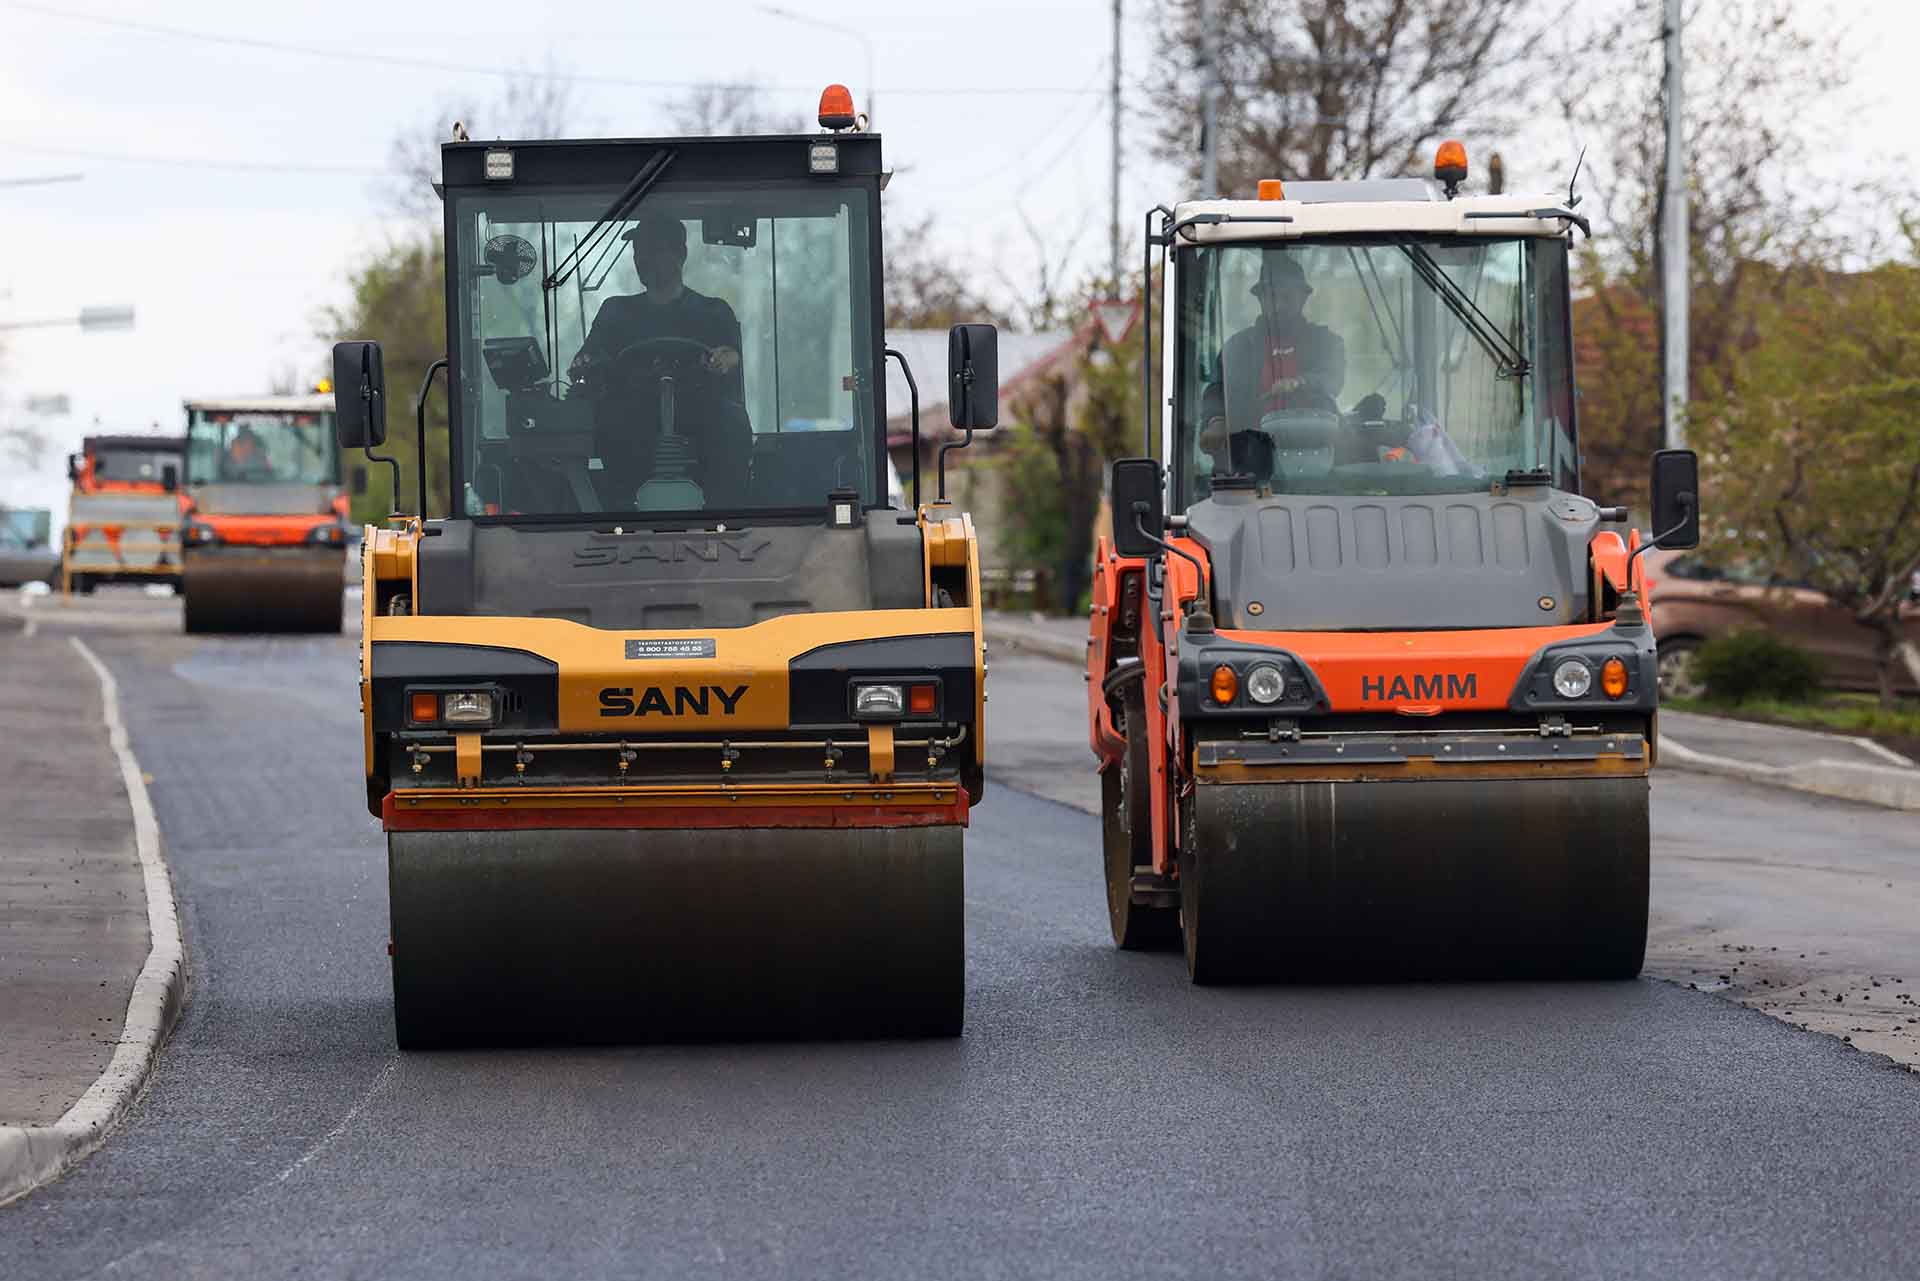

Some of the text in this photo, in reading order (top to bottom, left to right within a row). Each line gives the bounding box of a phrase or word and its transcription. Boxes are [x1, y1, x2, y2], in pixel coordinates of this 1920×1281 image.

[573, 540, 772, 568] SANY
[1361, 672, 1477, 700] HAMM
[598, 685, 749, 717] SANY
